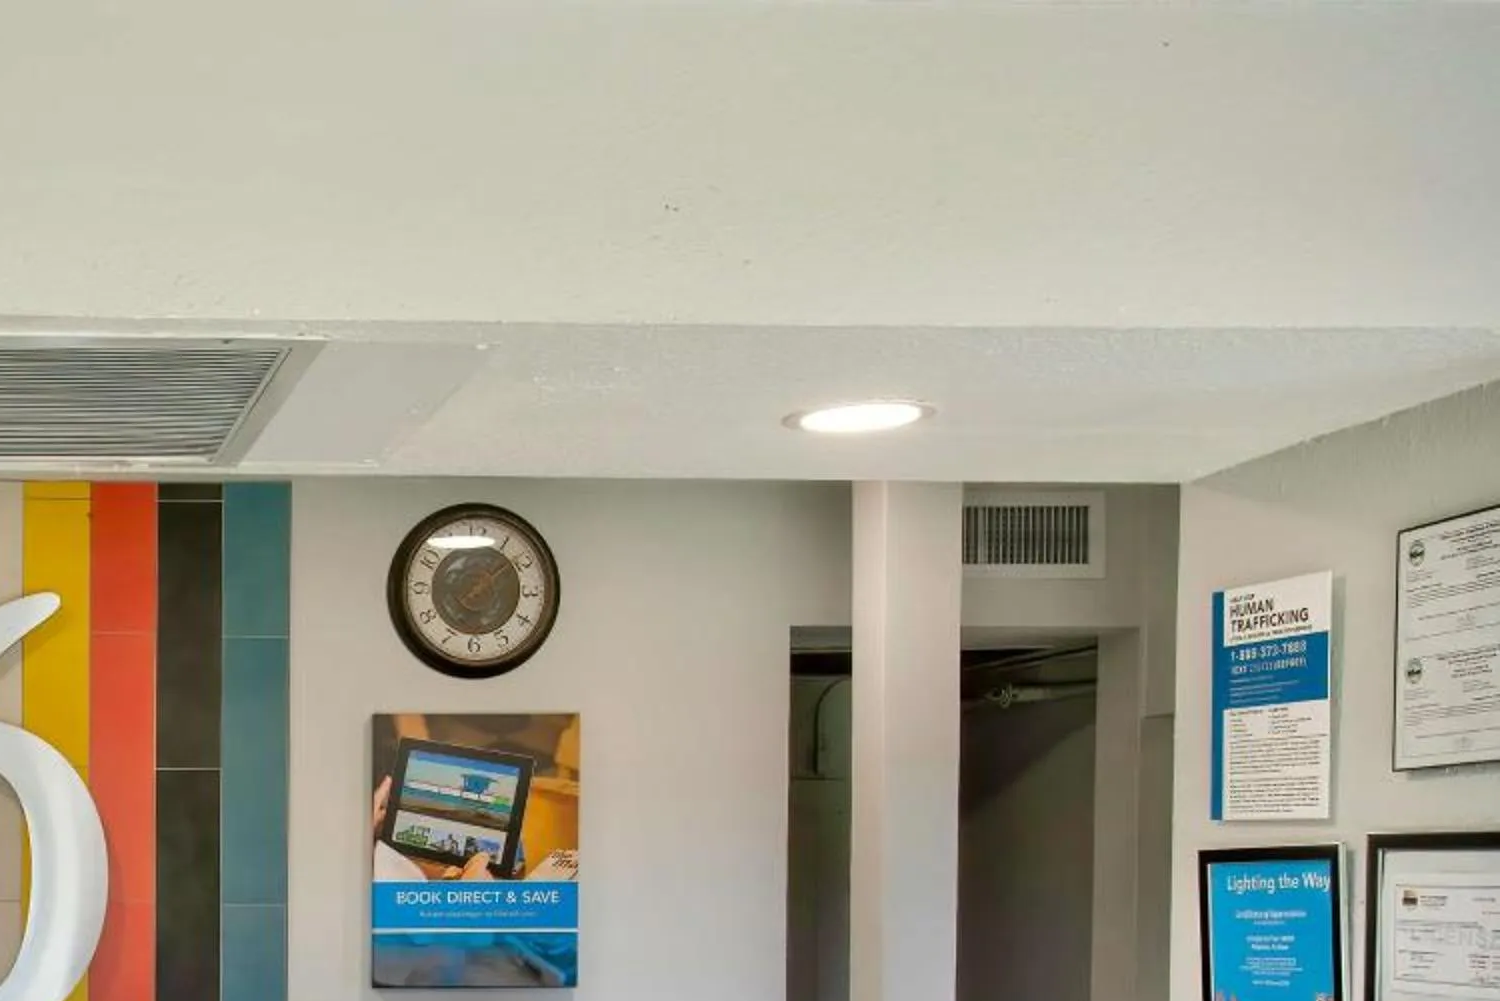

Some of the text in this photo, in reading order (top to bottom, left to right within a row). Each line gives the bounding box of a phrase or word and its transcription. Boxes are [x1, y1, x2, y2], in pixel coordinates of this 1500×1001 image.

[500, 536, 509, 550] 1
[419, 549, 440, 571] 10
[515, 551, 533, 573] 2
[413, 581, 428, 595] 9
[522, 583, 538, 598] 3
[1230, 599, 1274, 617] HUMAN
[419, 609, 437, 625] 8
[516, 611, 532, 627] 4
[1231, 607, 1309, 632] TRAFFICKING
[441, 627, 458, 645] 7
[467, 636, 481, 653] 6
[493, 630, 509, 648] 5
[1227, 871, 1332, 895] Lighting the Way
[396, 891, 561, 905] BOOK DIRECT & SAVE
